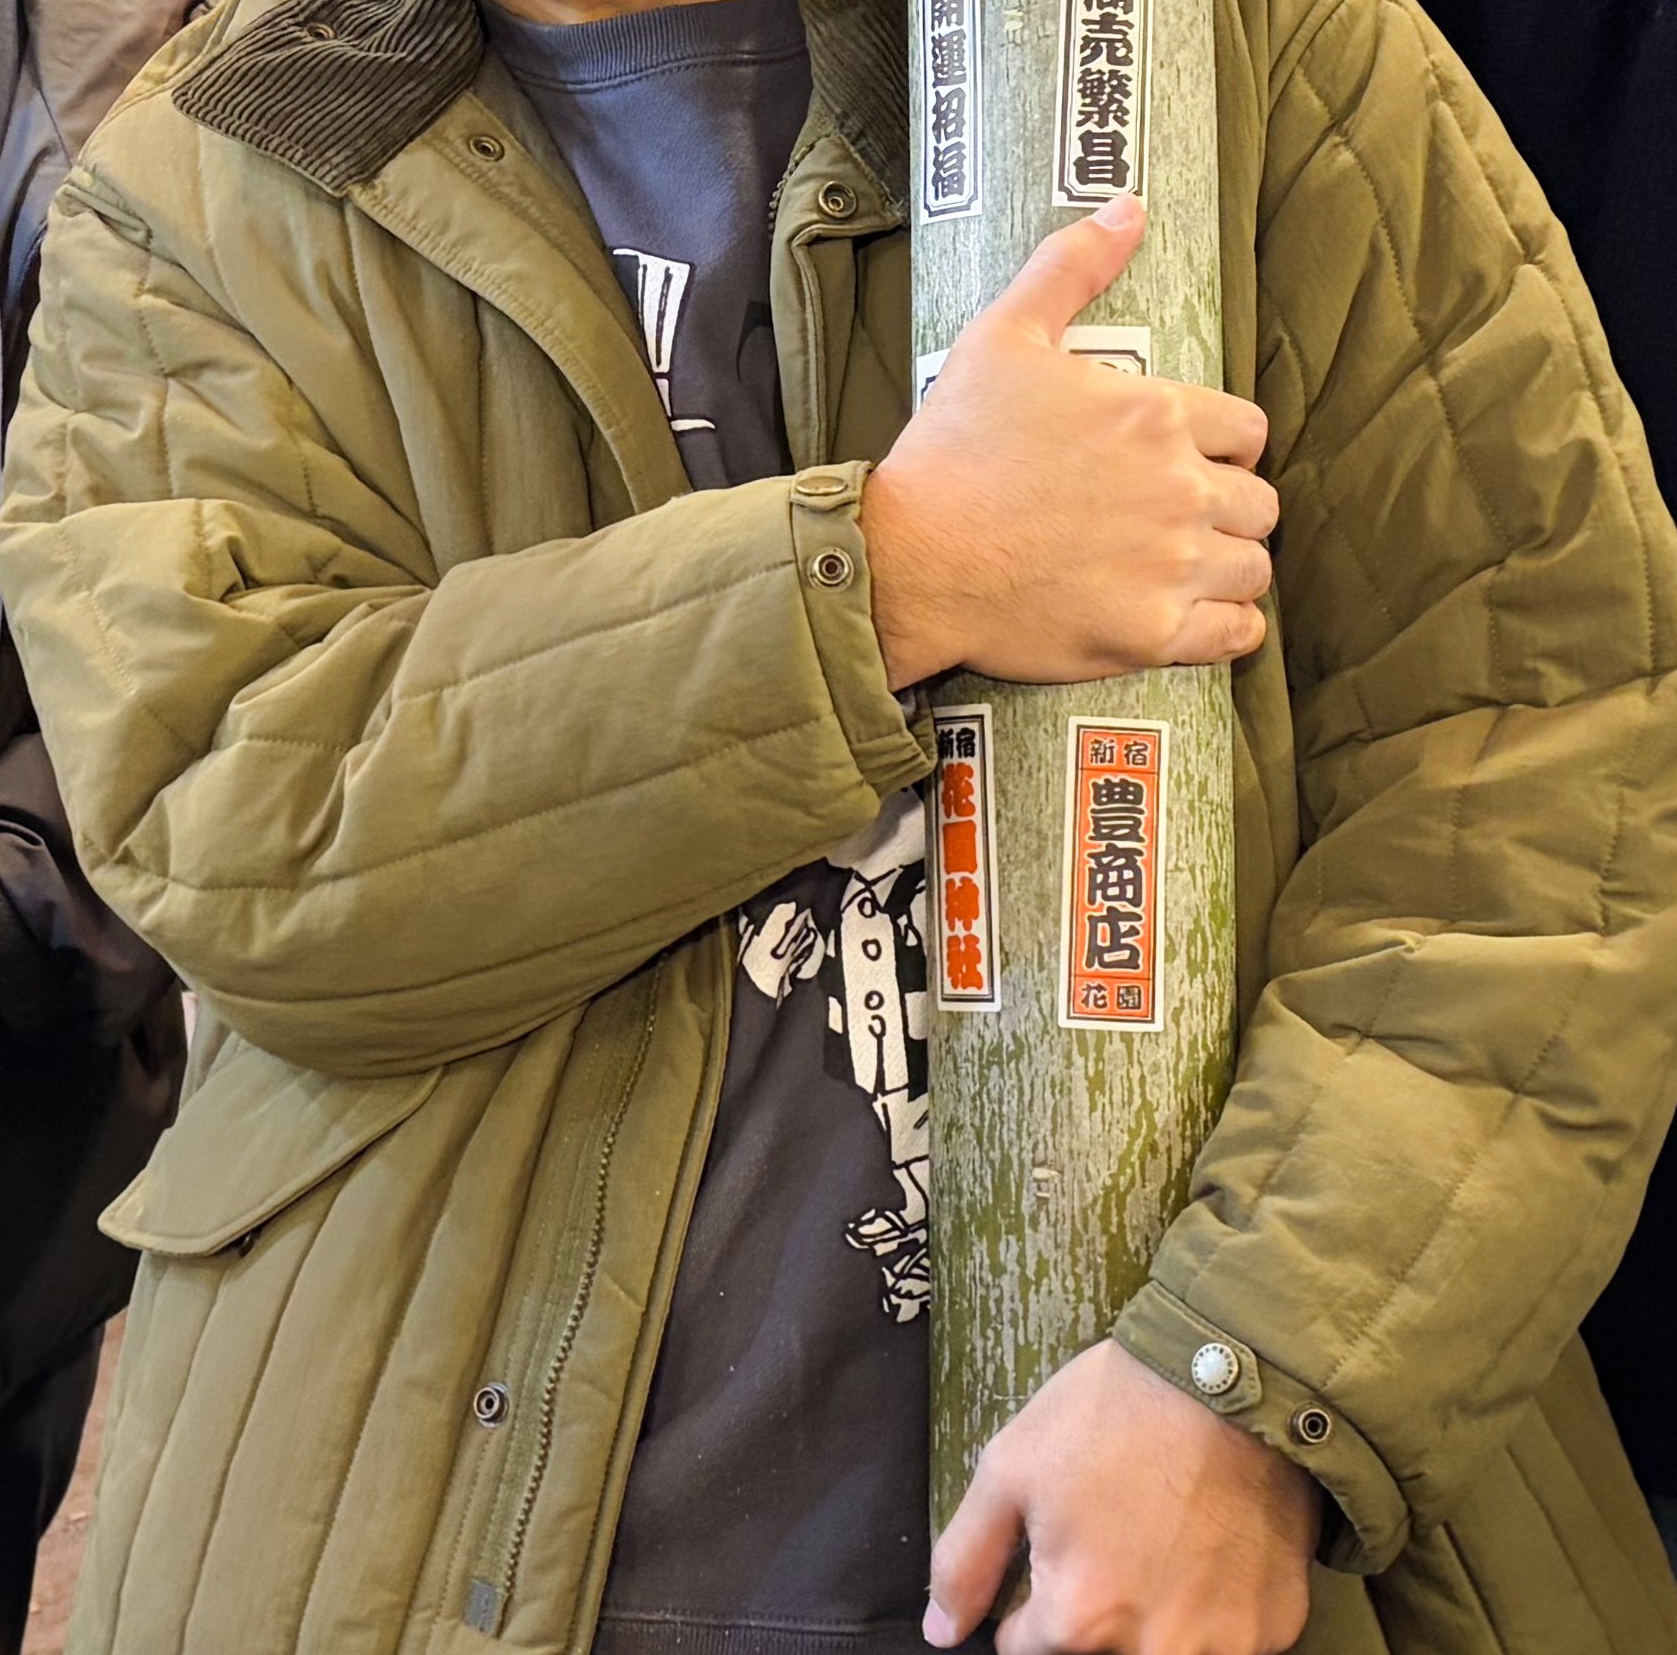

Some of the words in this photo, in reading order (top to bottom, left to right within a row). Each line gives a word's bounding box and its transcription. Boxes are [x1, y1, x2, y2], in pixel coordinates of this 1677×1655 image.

[938, 726, 977, 760] 新宿
[1089, 738, 1149, 767] 新宿
[1084, 777, 1146, 972] 豊商店
[1080, 982, 1142, 1011] 花園
